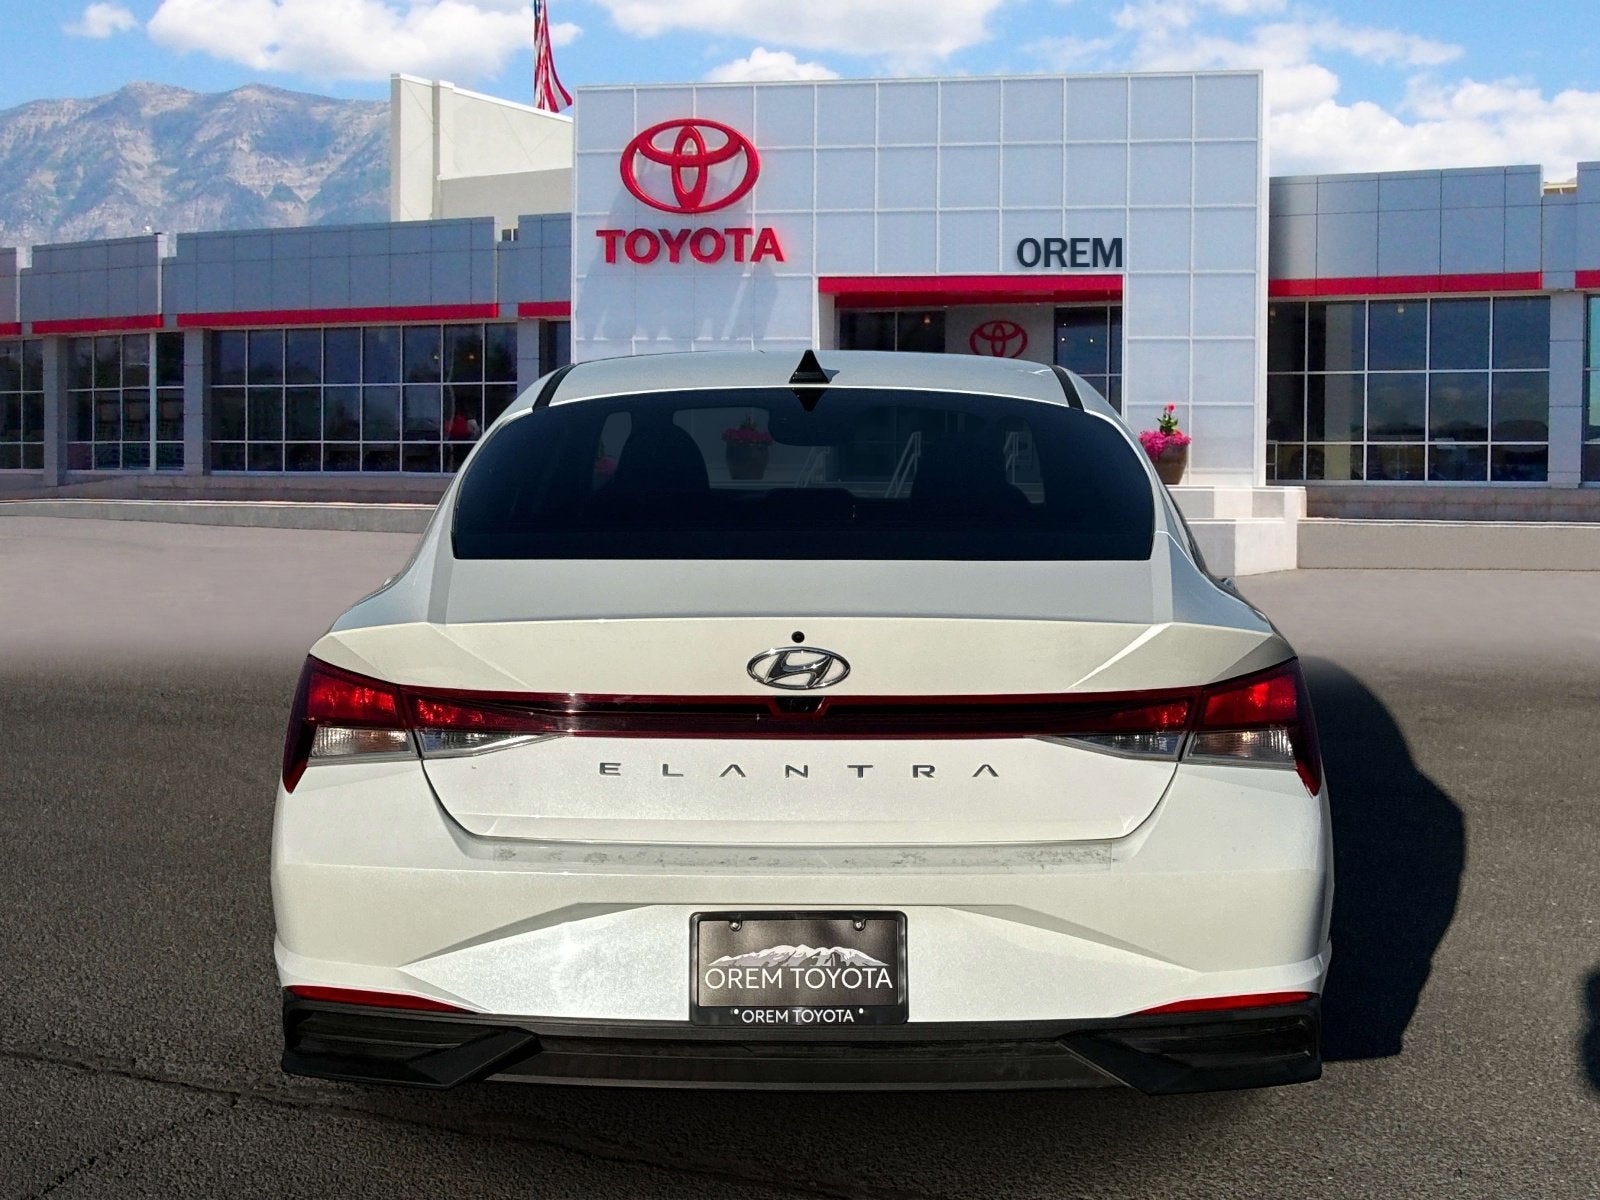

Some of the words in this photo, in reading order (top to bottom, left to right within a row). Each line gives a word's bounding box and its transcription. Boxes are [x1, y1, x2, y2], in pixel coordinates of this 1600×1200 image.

[596, 226, 785, 264] TOYOTA
[1016, 237, 1123, 268] OREM
[599, 762, 1000, 779] ELANTRA
[704, 967, 783, 990] OREM
[790, 967, 893, 990] TOYOTA
[741, 1009, 789, 1024] OREM
[792, 1009, 855, 1024] TOYOTA
